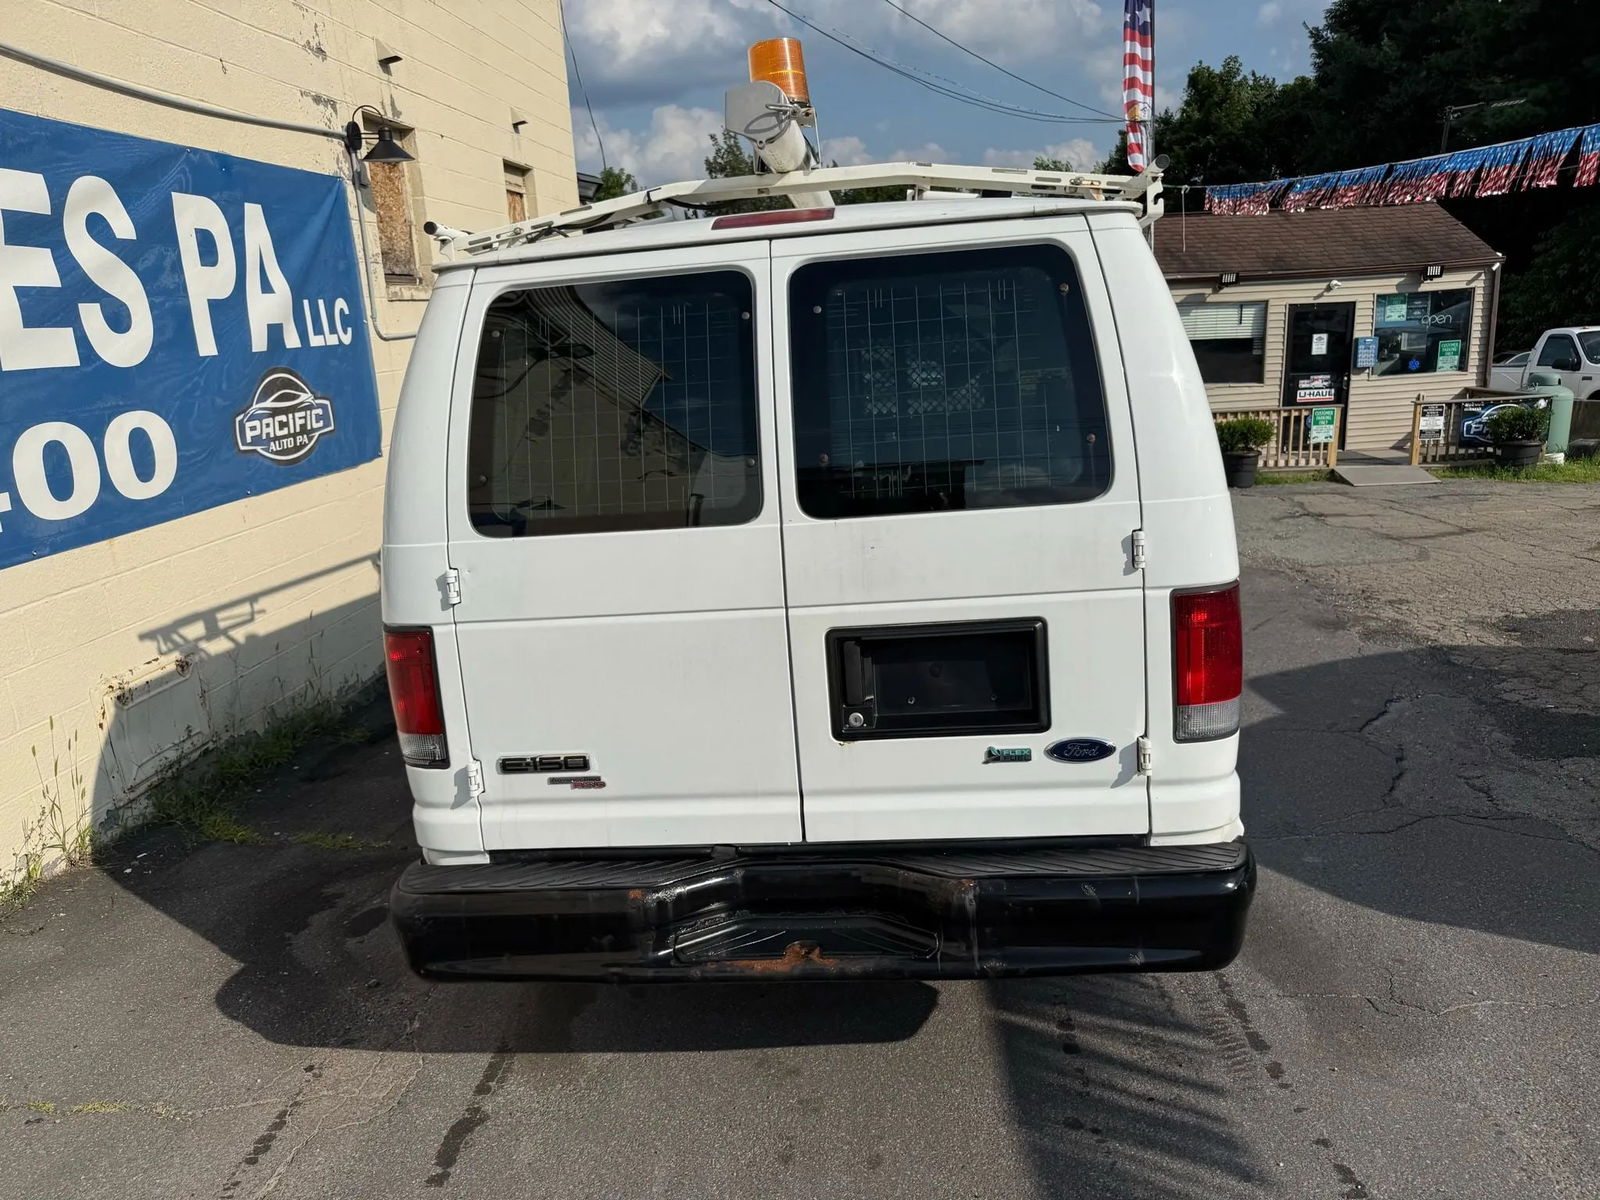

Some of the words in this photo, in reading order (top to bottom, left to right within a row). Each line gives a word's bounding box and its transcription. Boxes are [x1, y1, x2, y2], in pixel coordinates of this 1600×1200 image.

[171, 191, 302, 357] PA
[302, 297, 353, 348] LLC
[1421, 314, 1452, 326] open
[1298, 390, 1333, 398] U-HAUL
[245, 408, 324, 443] PACIFIC
[269, 437, 295, 453] AUTO
[296, 434, 309, 446] PA
[0, 410, 178, 532] 00
[1003, 748, 1030, 756] FLEX
[1063, 742, 1100, 757] Ford
[500, 755, 588, 773] E-150
